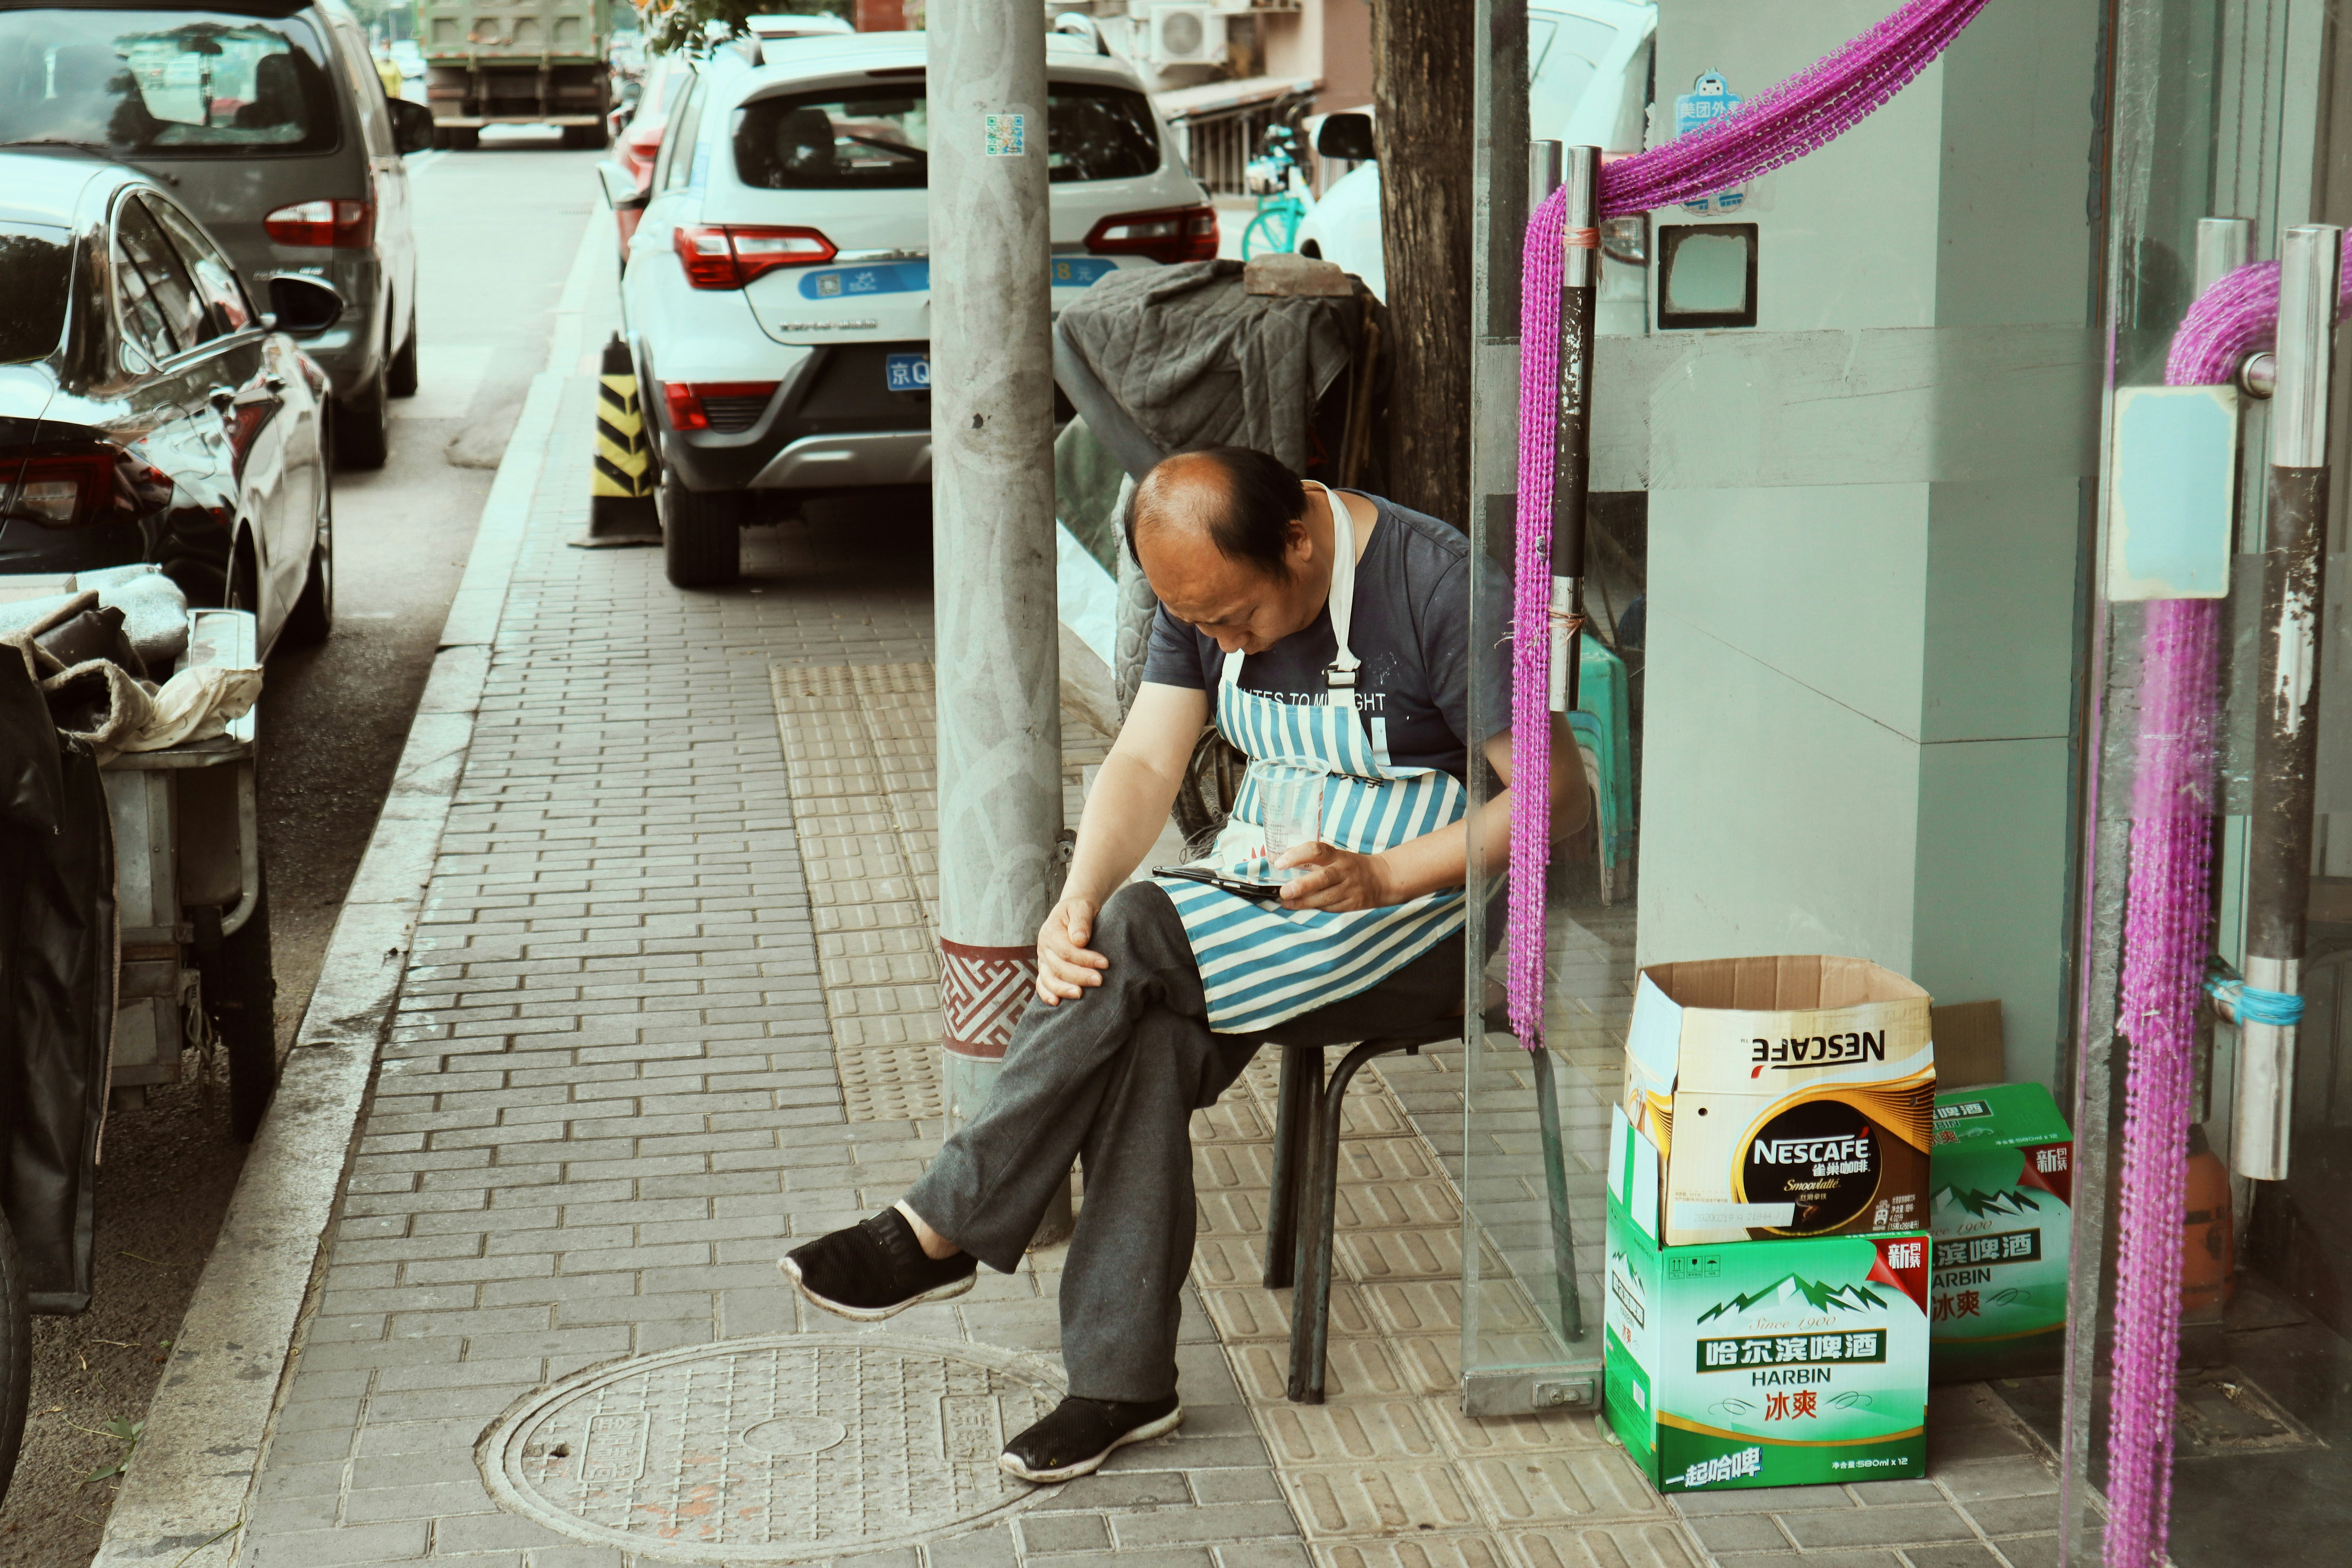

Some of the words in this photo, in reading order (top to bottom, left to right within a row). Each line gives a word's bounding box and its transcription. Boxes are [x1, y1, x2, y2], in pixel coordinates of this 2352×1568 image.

[1290, 693, 1310, 706] TO
[1813, 1160, 1868, 1177] 雀巢咖啡
[2036, 1148, 2067, 1173] 新包装
[1800, 1193, 1827, 1201] 丝滑拿铁
[1888, 1243, 1921, 1269] 新包装
[1933, 1233, 2031, 1267] 滨啤酒
[1932, 1268, 1991, 1290] ARBIN
[1750, 1317, 1790, 1330] Since
[1798, 1316, 1836, 1330] 1900
[1706, 1333, 1878, 1366] 哈尔滨啤酒
[1752, 1368, 1831, 1387] HARBIN
[1764, 1390, 1817, 1422] 冰爽
[1666, 1447, 1763, 1488] 一起哈啤
